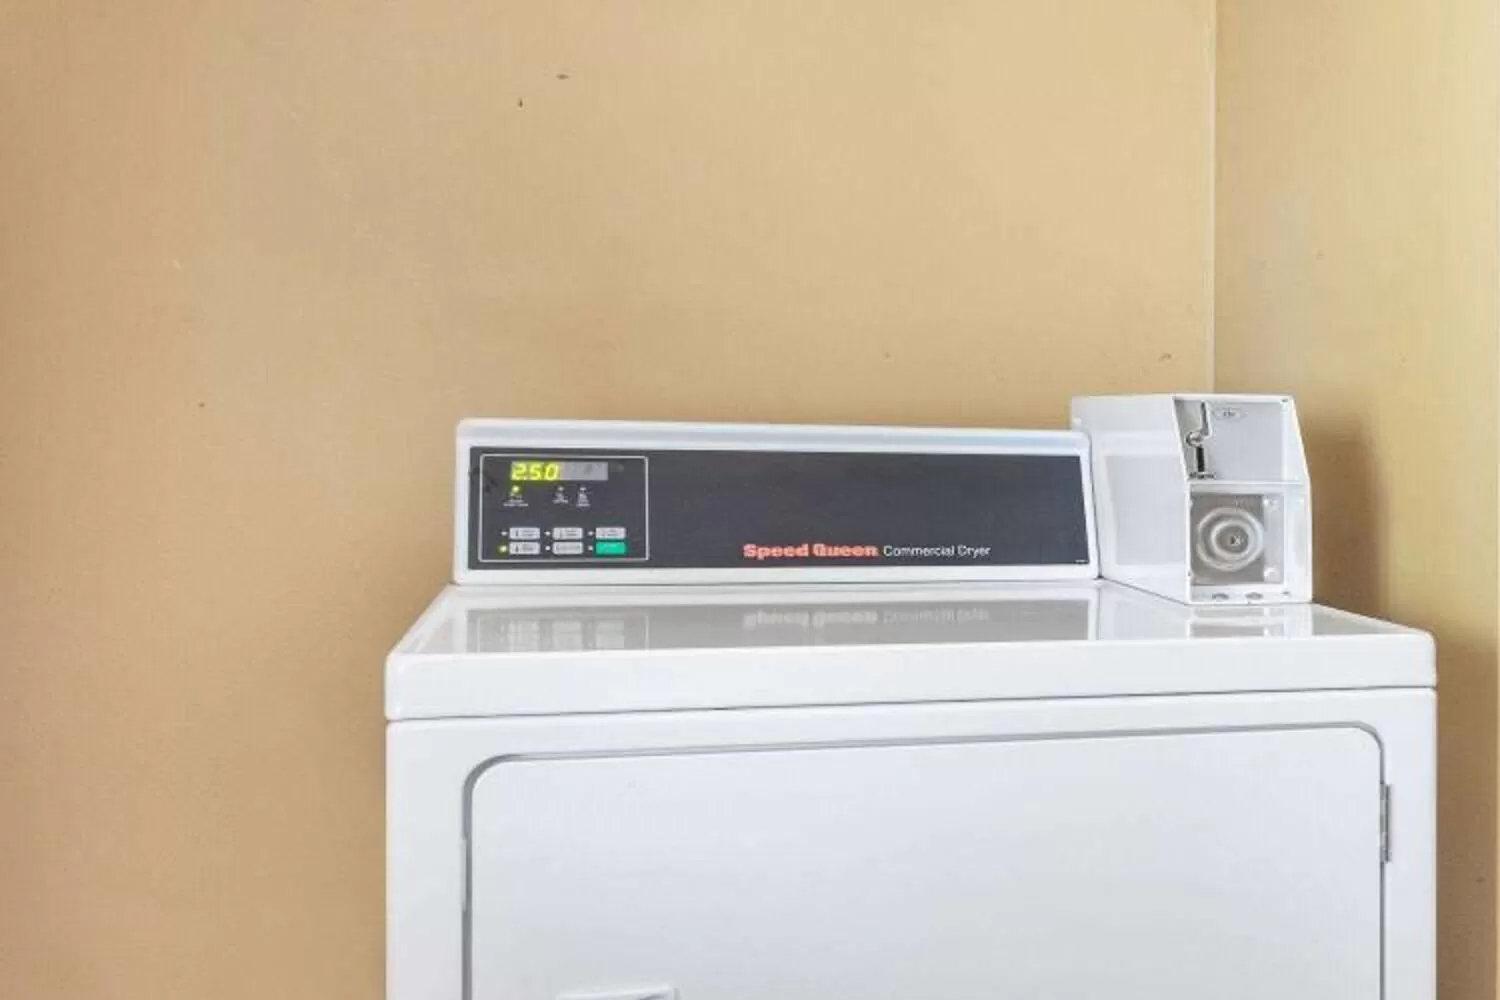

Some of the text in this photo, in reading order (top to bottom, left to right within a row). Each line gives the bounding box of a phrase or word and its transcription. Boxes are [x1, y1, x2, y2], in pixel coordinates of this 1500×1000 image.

[743, 543, 991, 560] Speed Queen Commercial Dryer
